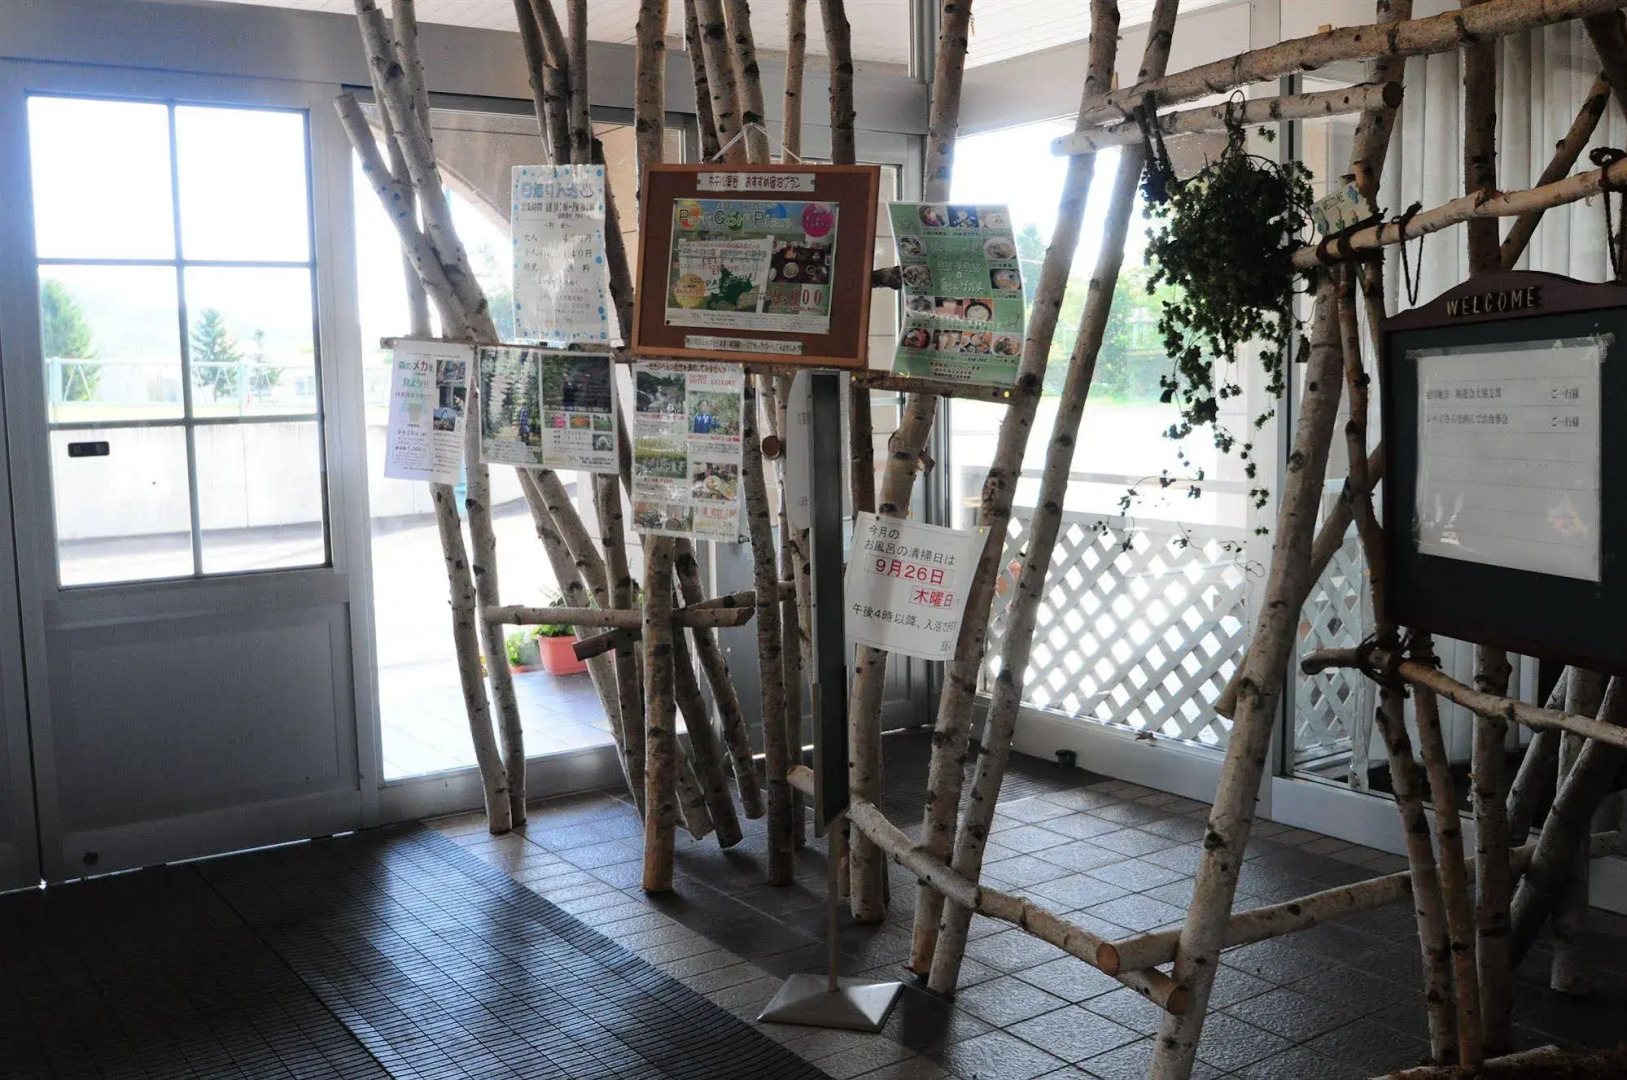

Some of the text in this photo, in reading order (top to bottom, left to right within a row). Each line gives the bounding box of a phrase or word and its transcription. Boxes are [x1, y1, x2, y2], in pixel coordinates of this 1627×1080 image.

[1446, 286, 1537, 317] WELCOME
[1551, 387, 1580, 400] ご一行様
[1551, 416, 1580, 429] ご一行様
[868, 524, 900, 541] 今月の
[864, 539, 956, 566] お風呂の清掃日は
[875, 558, 945, 586] 9月26日
[913, 588, 954, 608] 木曜日
